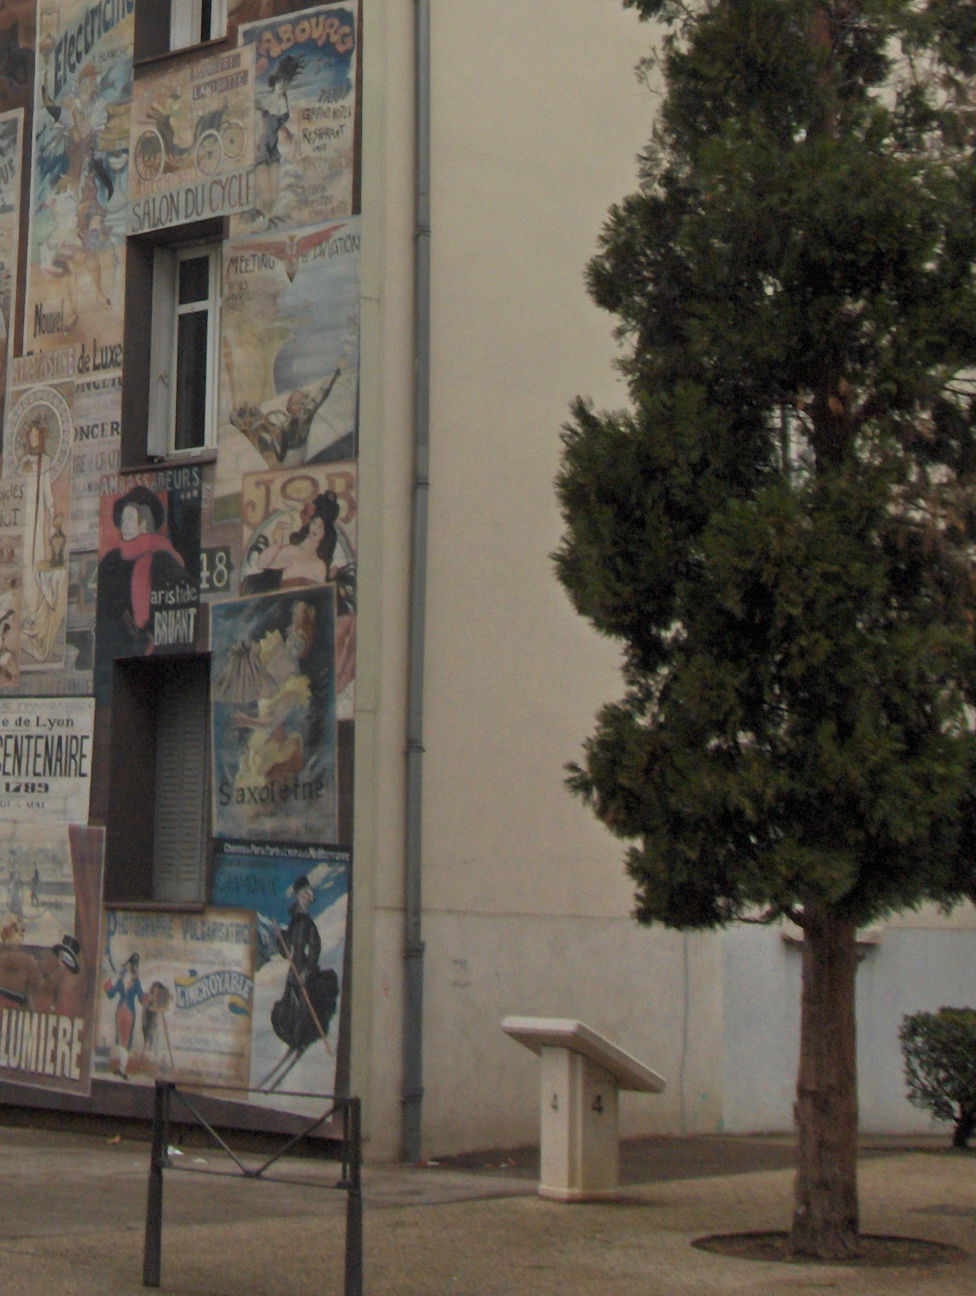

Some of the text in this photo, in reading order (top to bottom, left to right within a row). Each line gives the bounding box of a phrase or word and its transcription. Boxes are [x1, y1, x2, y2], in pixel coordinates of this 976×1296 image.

[132, 190, 180, 232] SALON
[185, 184, 205, 219] DU
[209, 170, 252, 213] CYCLE
[226, 253, 276, 275] MEETING
[77, 344, 91, 374] de
[93, 338, 123, 372] Luxe
[100, 466, 202, 495] AMBASSADEURS
[241, 471, 358, 530] JOB
[201, 551, 229, 589] 18
[154, 607, 197, 646] BRUANT
[15, 715, 30, 727] de
[35, 715, 74, 731] Lyon
[4, 781, 50, 794] 1789
[176, 971, 253, 1005] L'INCROYABLE
